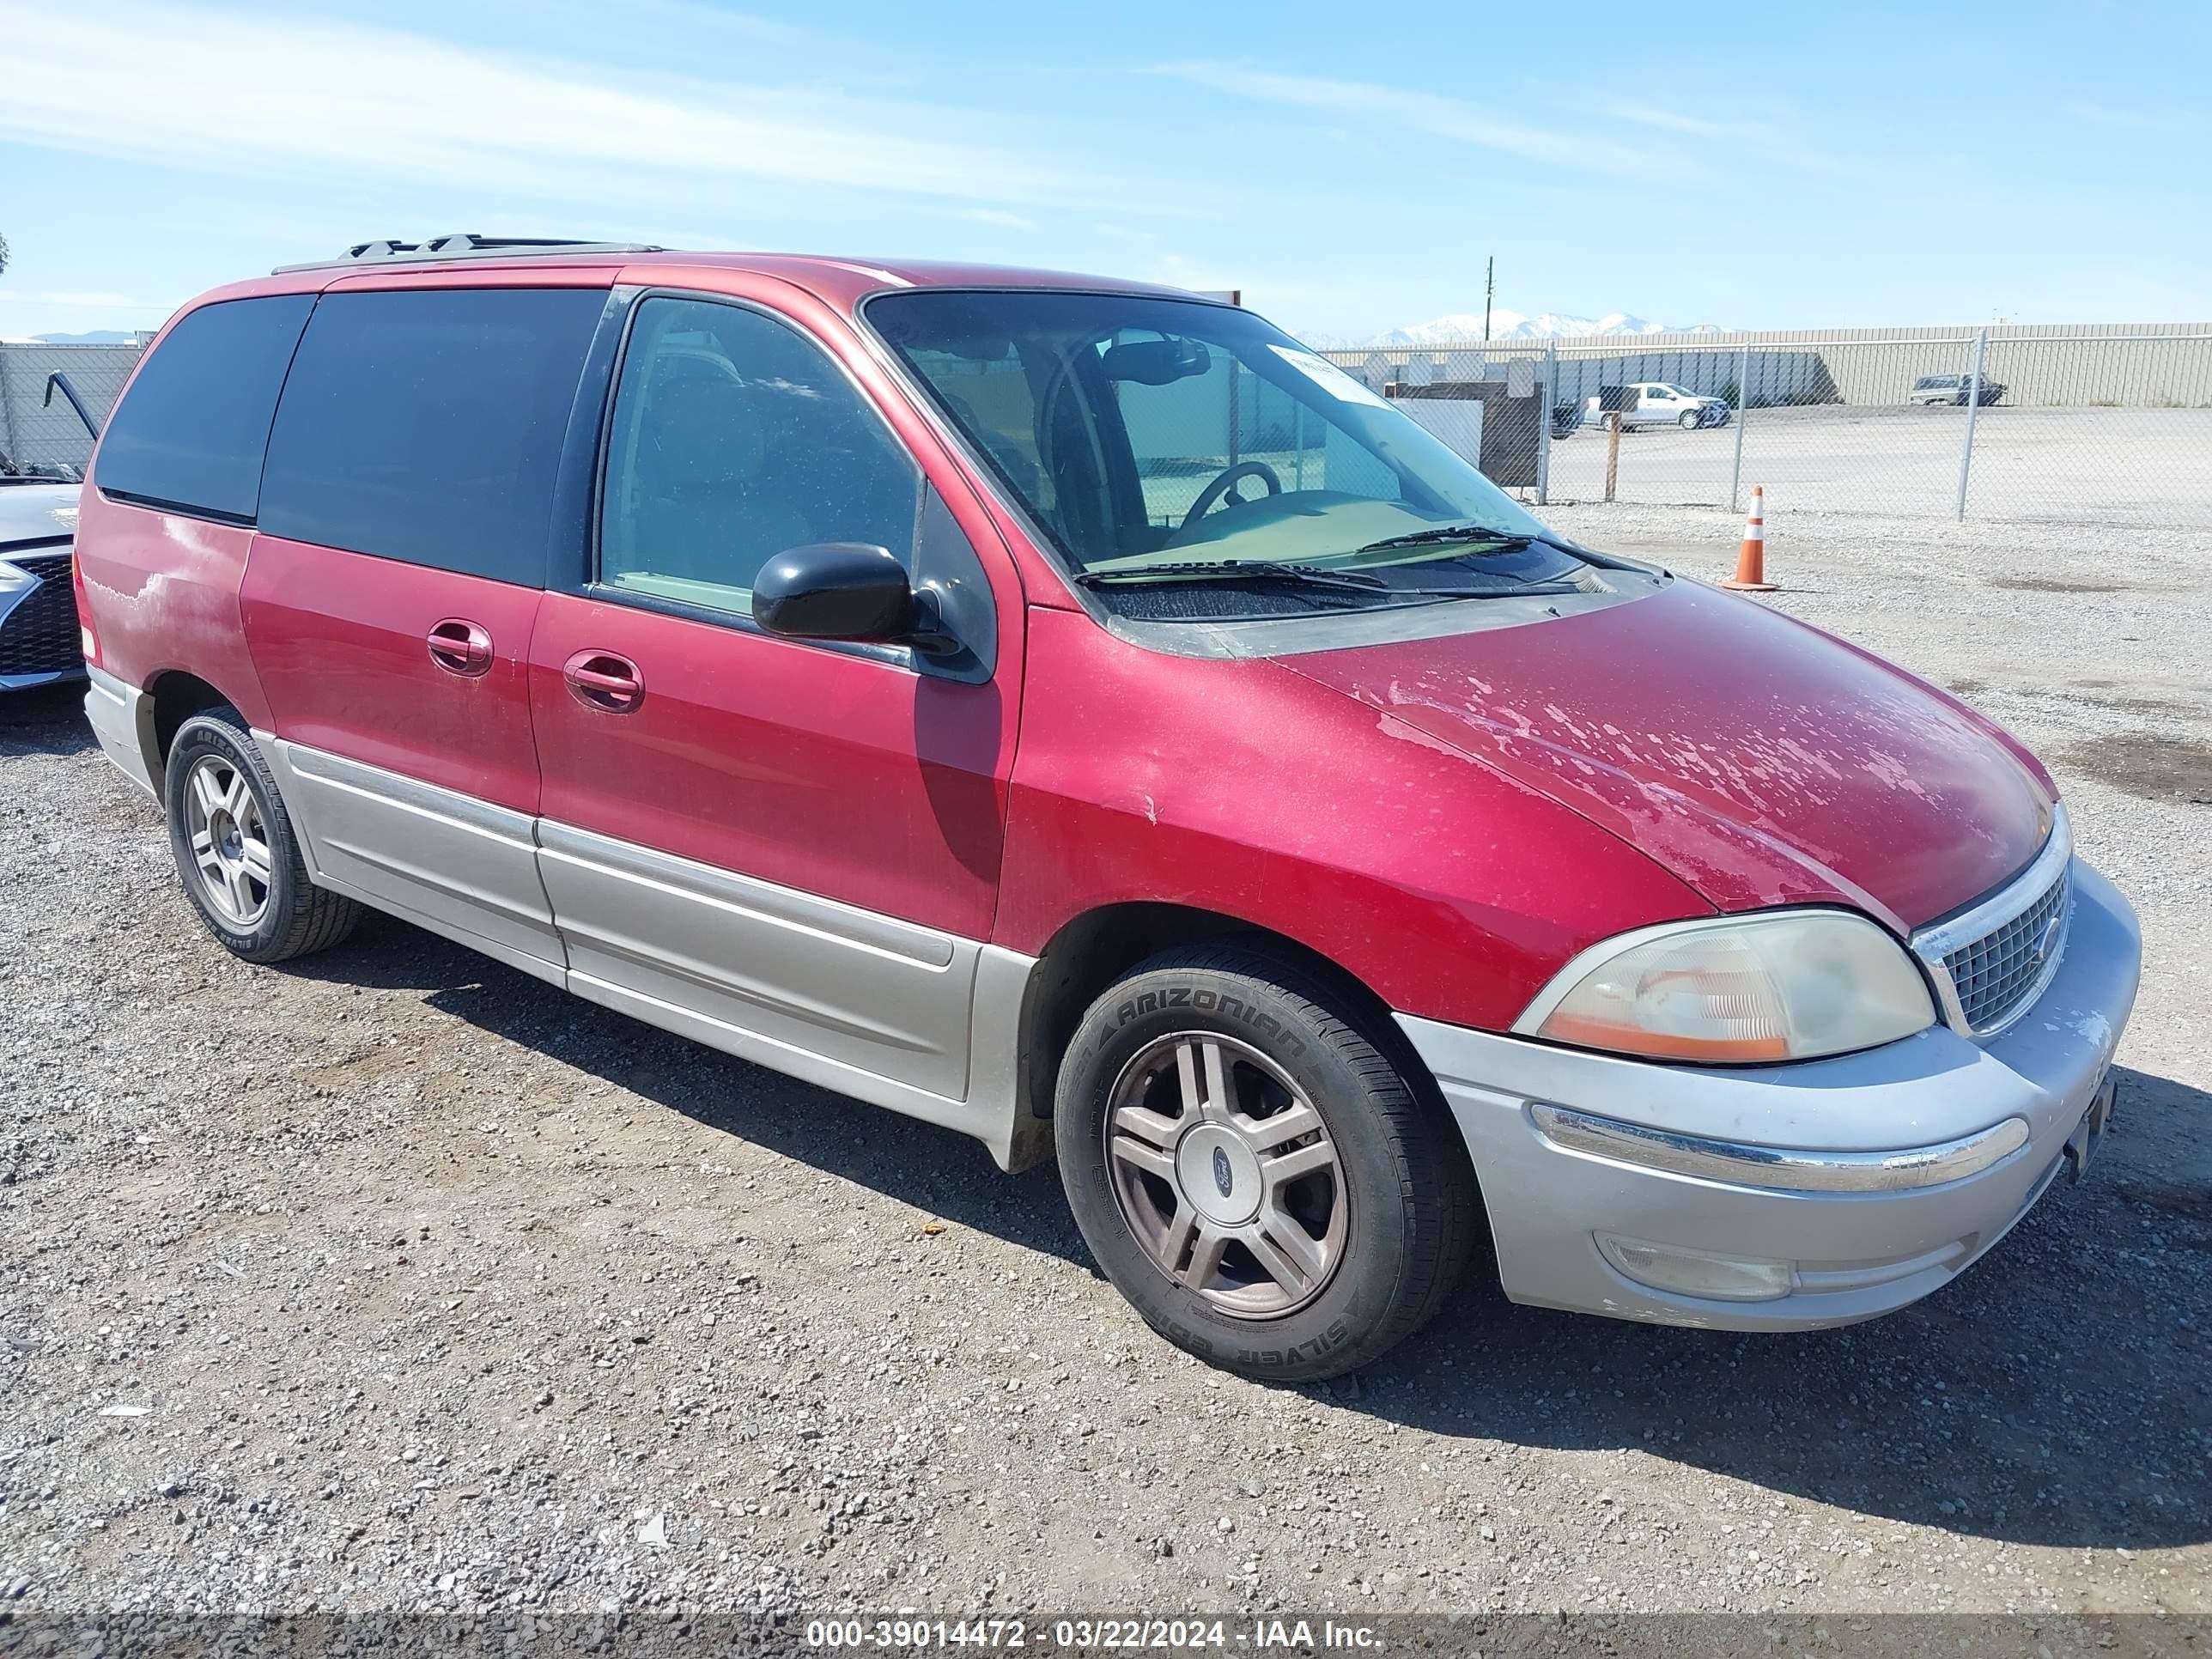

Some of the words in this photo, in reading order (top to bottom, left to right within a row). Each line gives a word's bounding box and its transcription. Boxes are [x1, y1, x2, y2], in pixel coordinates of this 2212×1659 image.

[1116, 988, 1307, 1058] ARIZONIAN
[1217, 1158, 1230, 1188] Ford
[1237, 1318, 1349, 1367] SILVER
